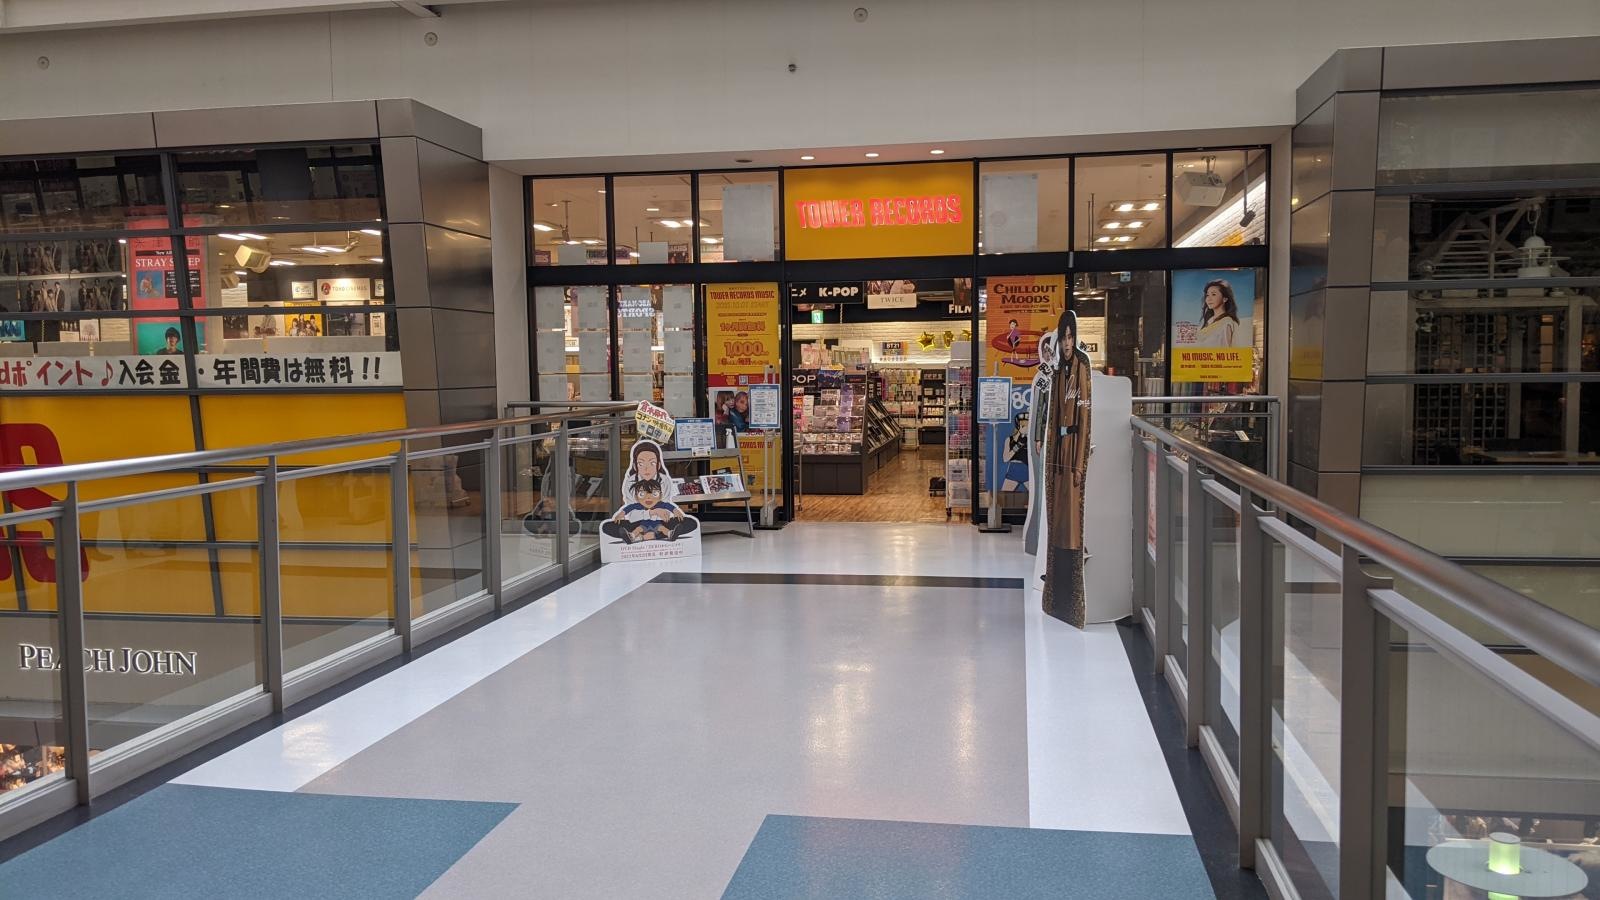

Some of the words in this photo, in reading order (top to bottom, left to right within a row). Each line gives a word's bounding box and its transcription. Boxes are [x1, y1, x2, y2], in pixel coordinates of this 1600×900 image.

[796, 200, 864, 228] TOWER
[870, 196, 961, 225] RECORDS
[135, 258, 167, 268] STRAY
[169, 257, 201, 267] SEP
[818, 287, 859, 297] K-POP
[993, 284, 1058, 294] CHILLOUT
[710, 292, 729, 300] TOWER
[730, 291, 754, 299] RECORDS
[755, 291, 775, 299] MUSIC
[1001, 294, 1050, 304] MOODS
[724, 341, 763, 358] 1,000
[1182, 353, 1191, 361] NO
[118, 647, 197, 675] JOHN
